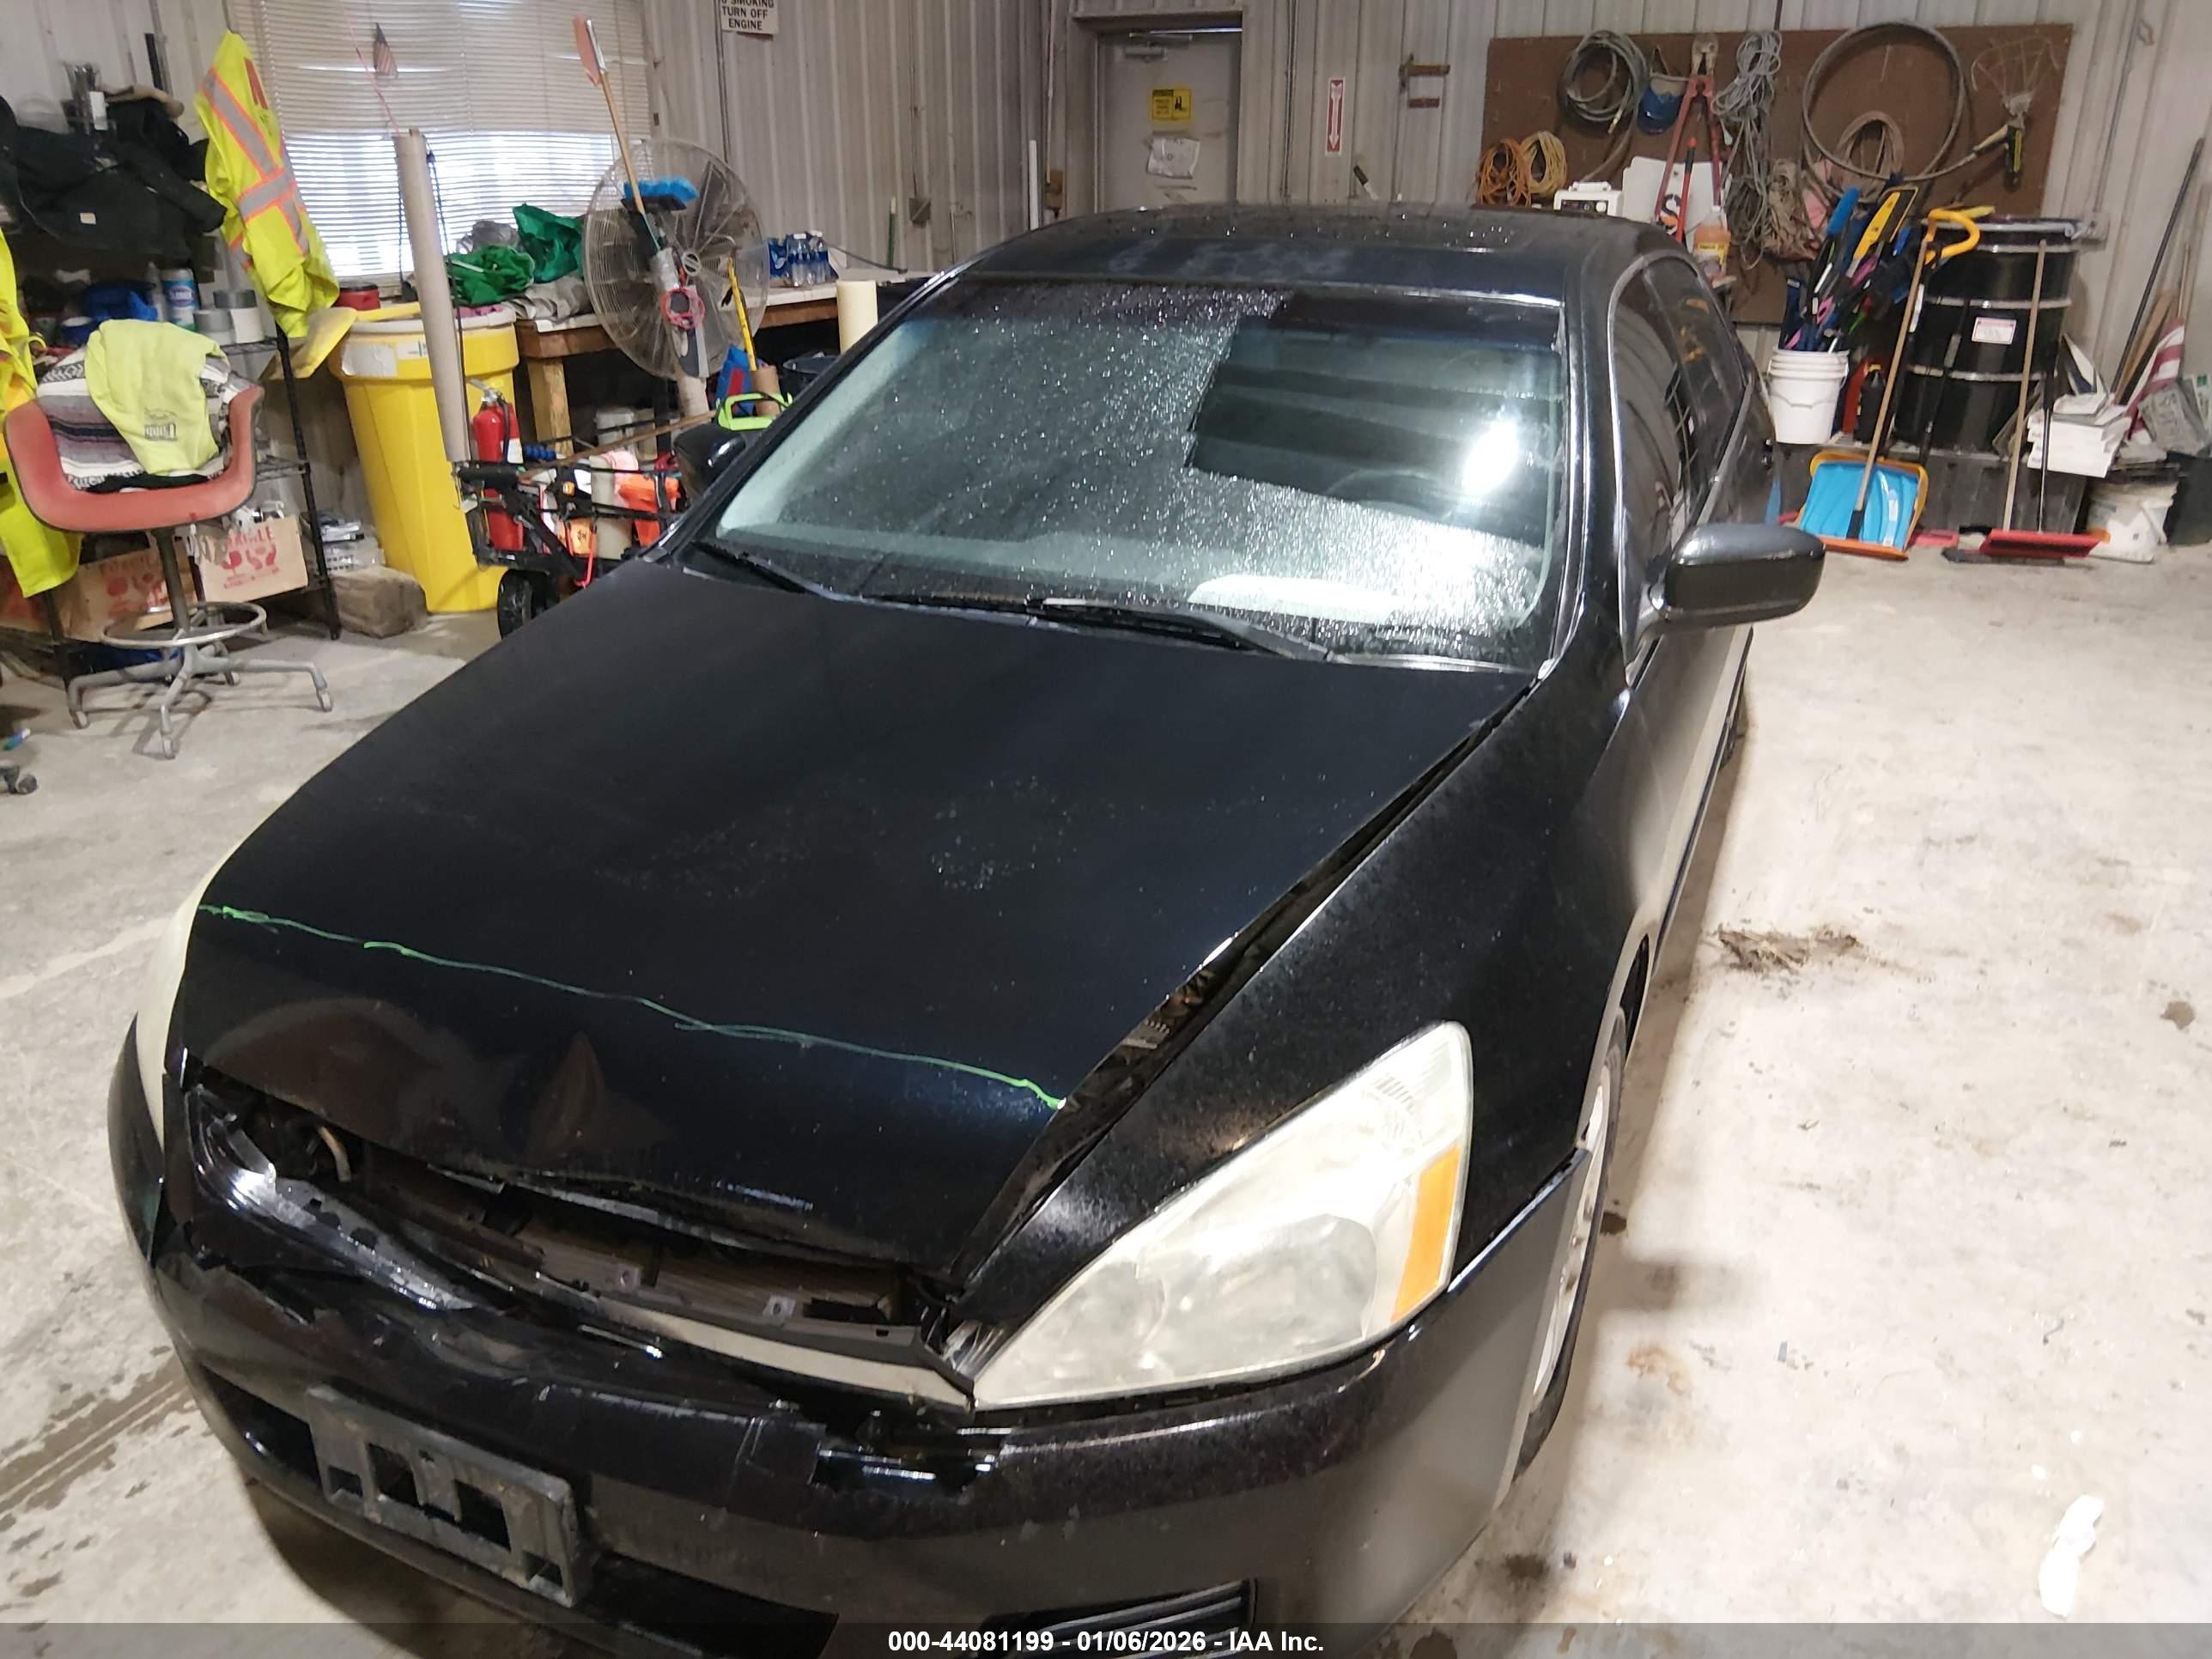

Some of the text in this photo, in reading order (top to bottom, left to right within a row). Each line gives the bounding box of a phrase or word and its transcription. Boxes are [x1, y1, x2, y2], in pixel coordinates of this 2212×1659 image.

[721, 6, 769, 19] TURN OFF
[728, 18, 763, 30] ENGINE
